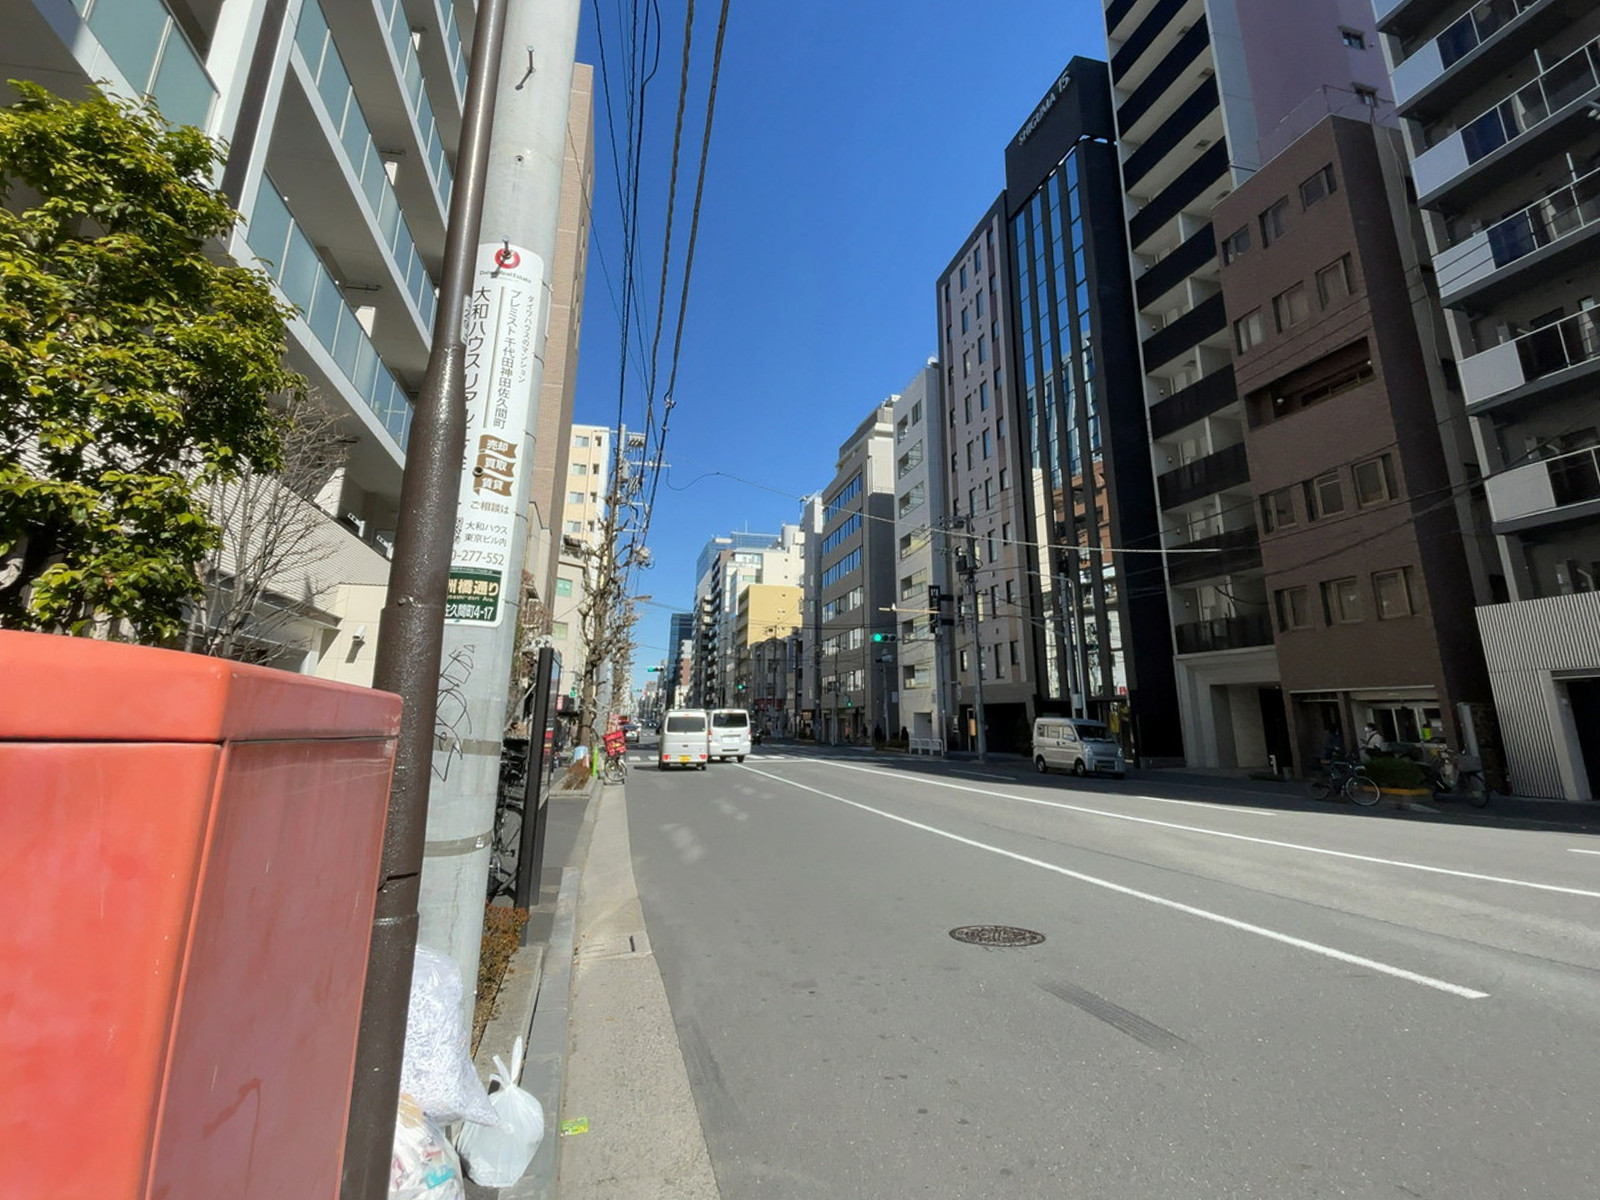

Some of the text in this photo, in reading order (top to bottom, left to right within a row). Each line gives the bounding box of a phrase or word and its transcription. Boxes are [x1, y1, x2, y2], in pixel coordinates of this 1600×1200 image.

[470, 501, 510, 514] ご相談は
[465, 521, 508, 535] 大和ハウス
[464, 532, 508, 548] 東京ビル内
